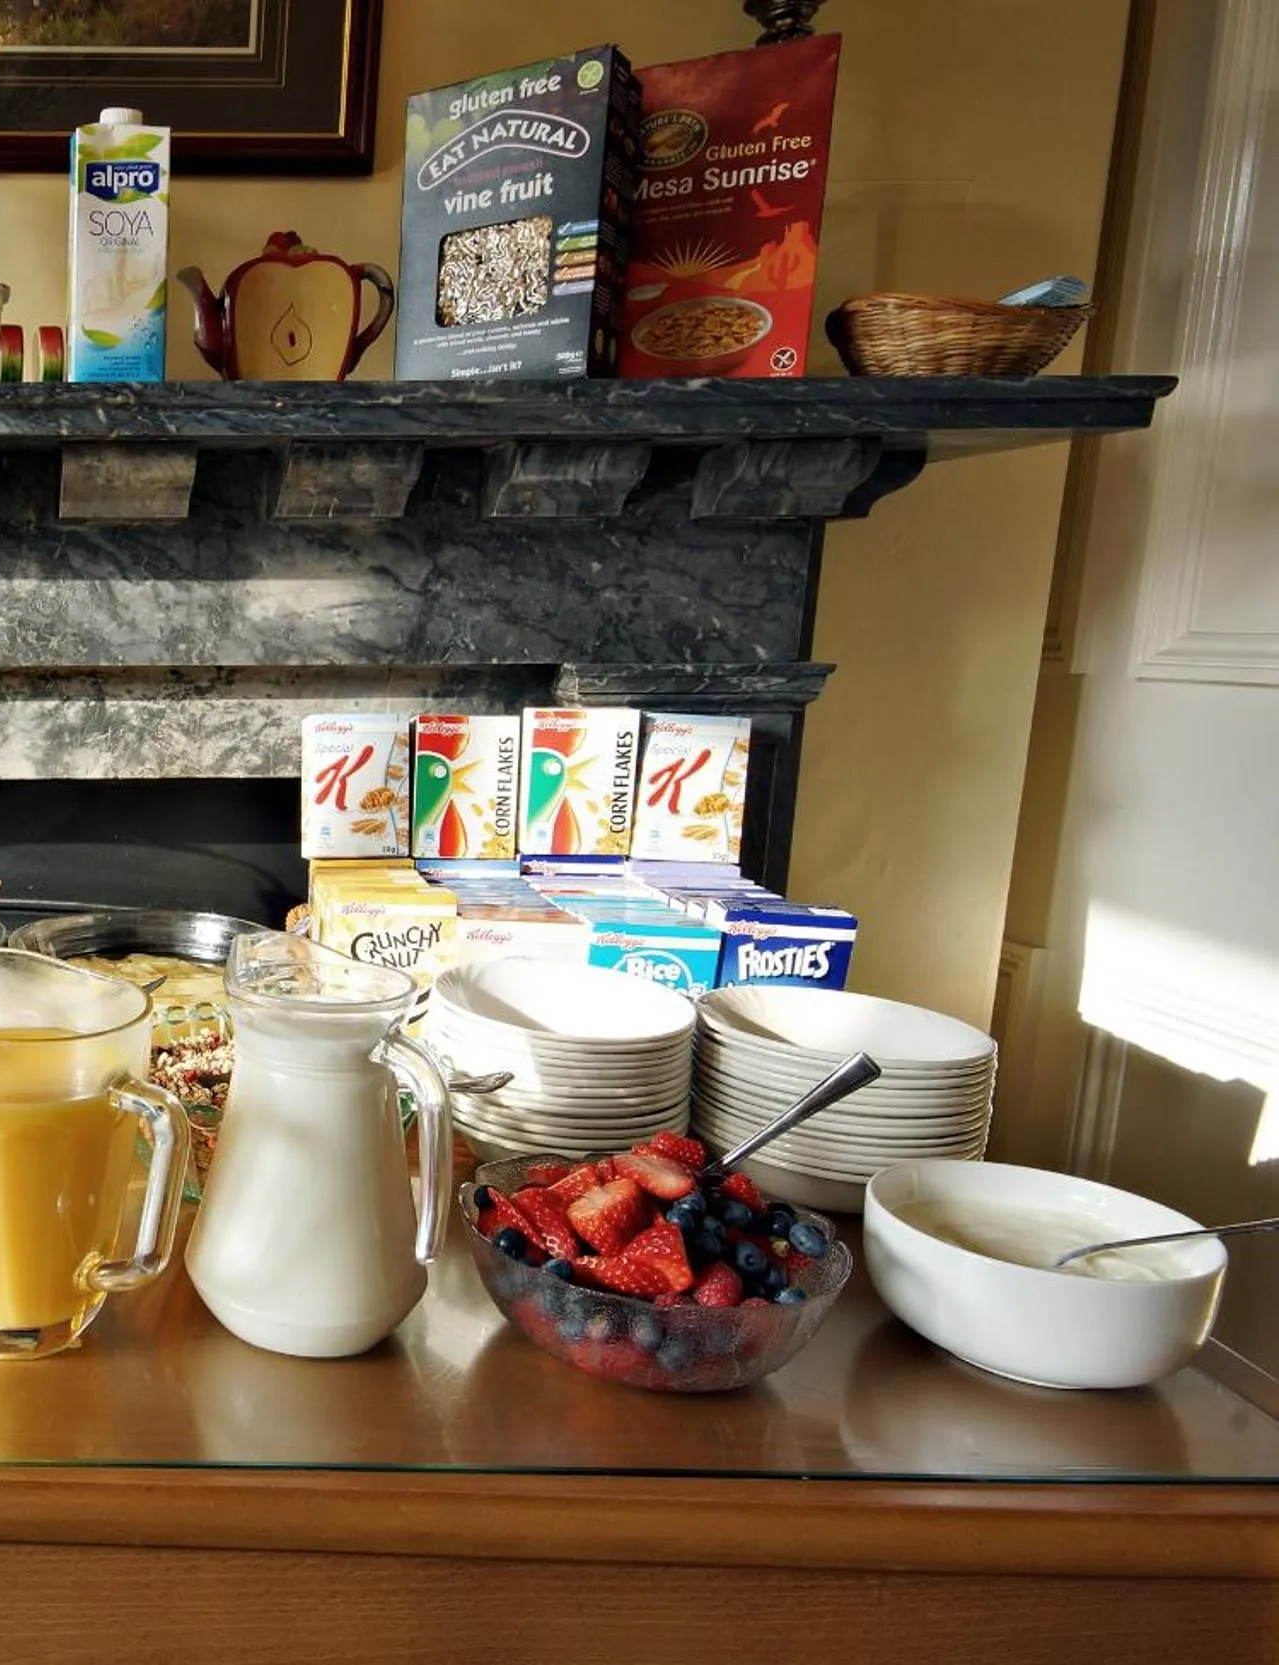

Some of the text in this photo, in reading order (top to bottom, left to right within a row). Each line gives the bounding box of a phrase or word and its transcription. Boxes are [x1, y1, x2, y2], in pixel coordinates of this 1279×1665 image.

[449, 73, 562, 120] gluten free
[428, 141, 467, 179] EAT
[471, 119, 579, 151] NATURAL
[705, 142, 767, 162] Gluten
[772, 134, 812, 151] Free
[91, 164, 154, 194] alpro
[443, 171, 554, 215] vine fruit
[88, 210, 154, 237] SOYA
[314, 744, 375, 812] K
[495, 736, 514, 838] CORN FLAKES
[610, 731, 635, 835] CORN FLAKES
[647, 748, 712, 814] K
[341, 901, 388, 917] Kellogg's
[350, 921, 443, 961] CRUNCHY
[465, 927, 514, 944] Kellogg's
[595, 931, 646, 947] Kellogg's
[727, 920, 779, 940] Kellogg's
[380, 947, 425, 968] NUT
[626, 956, 682, 982] Rice
[737, 941, 833, 982] FROSTIES
